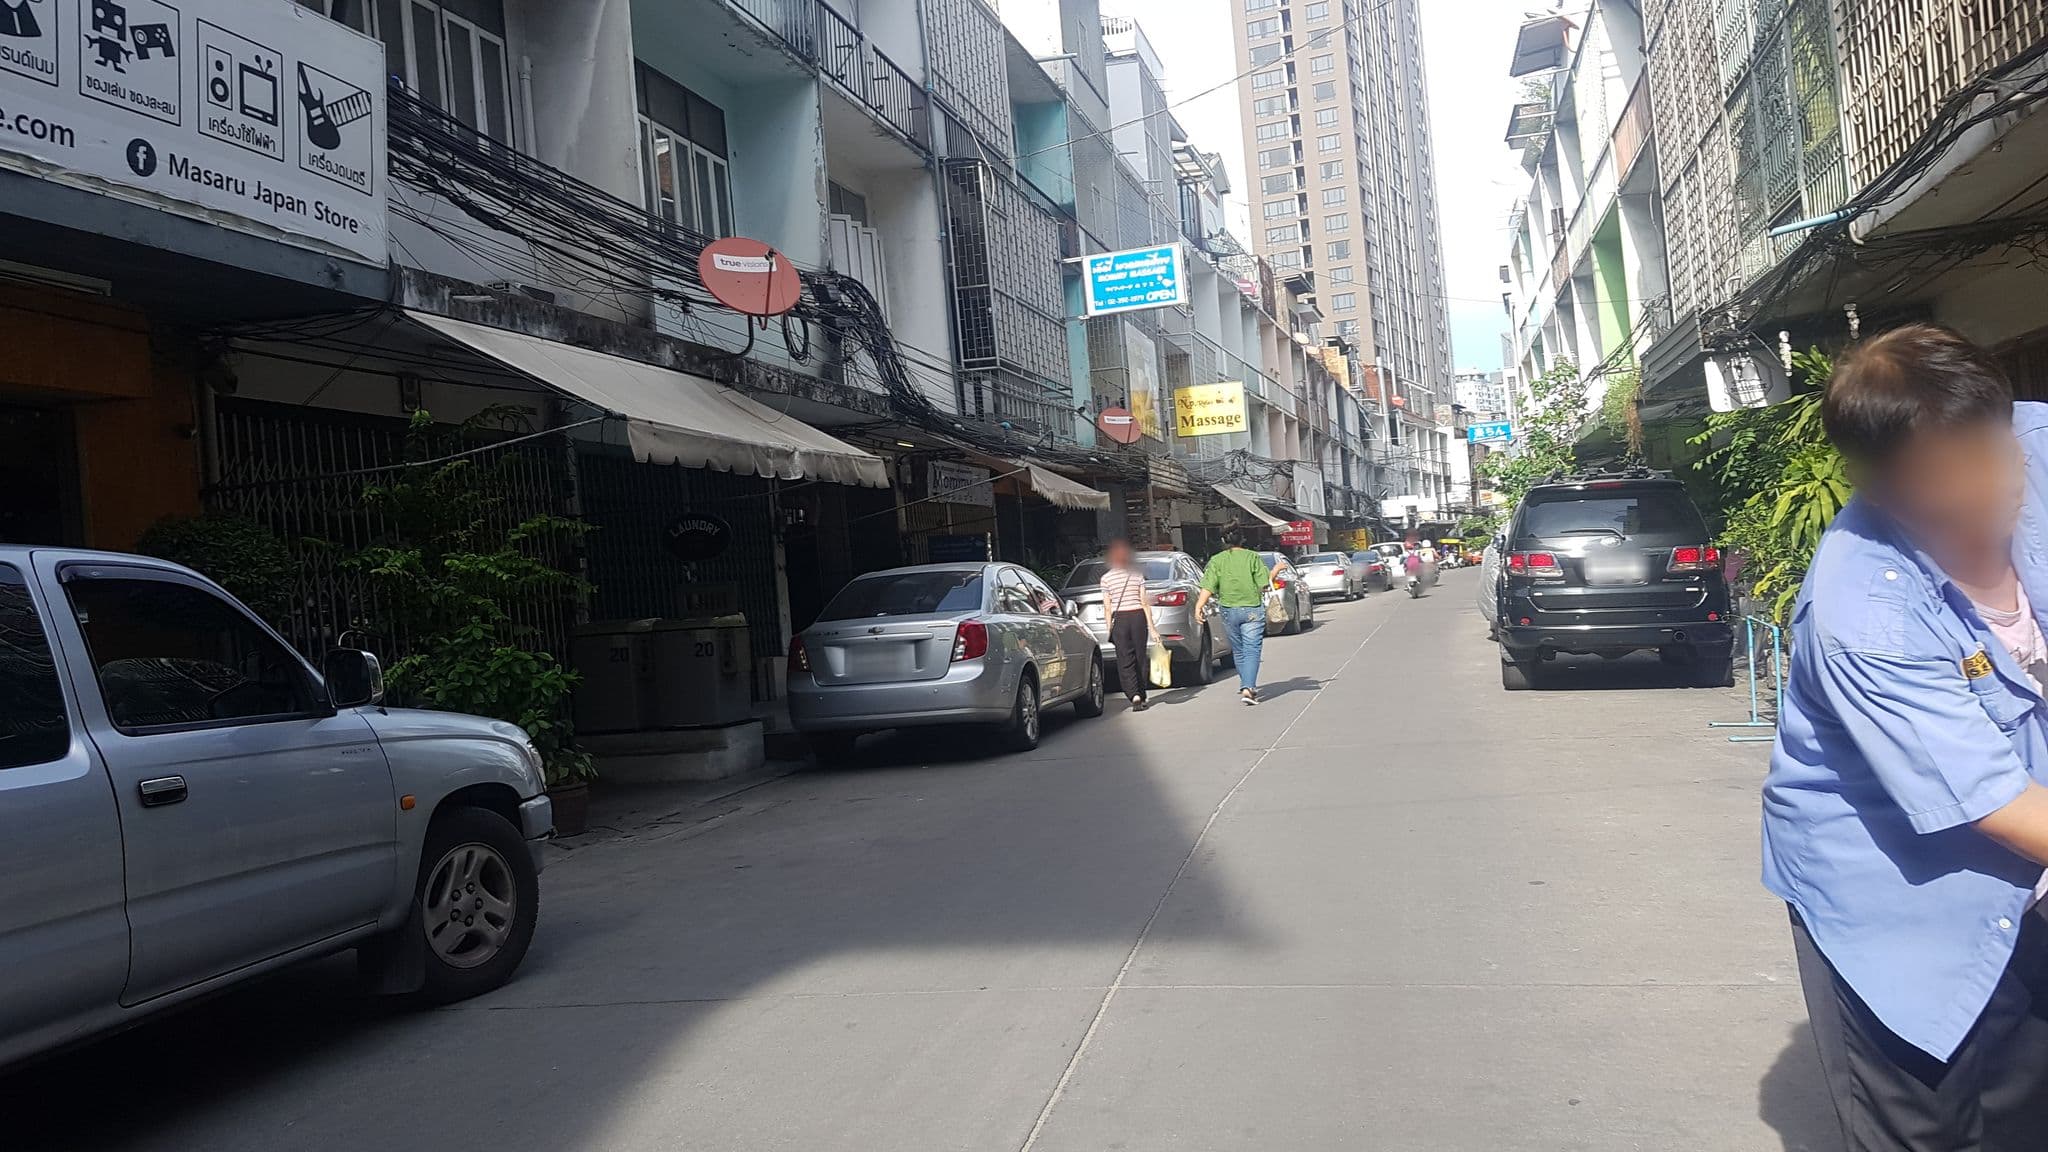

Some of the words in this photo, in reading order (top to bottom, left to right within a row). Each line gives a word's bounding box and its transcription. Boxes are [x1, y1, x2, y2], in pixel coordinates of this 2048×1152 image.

[86, 75, 126, 99] ของเล่น
[208, 117, 276, 152] เครื่องใช้ไฟฟ้า
[308, 152, 366, 186] เครื่องดนตรี
[168, 152, 246, 197] Masaru
[253, 180, 307, 216] Japan
[314, 200, 358, 234] Store
[720, 258, 741, 266] true
[1145, 288, 1176, 302] OPEN
[1180, 414, 1241, 428] Massage
[669, 519, 721, 537] LAUNDRY
[608, 647, 629, 663] 20
[695, 641, 714, 657] 20
